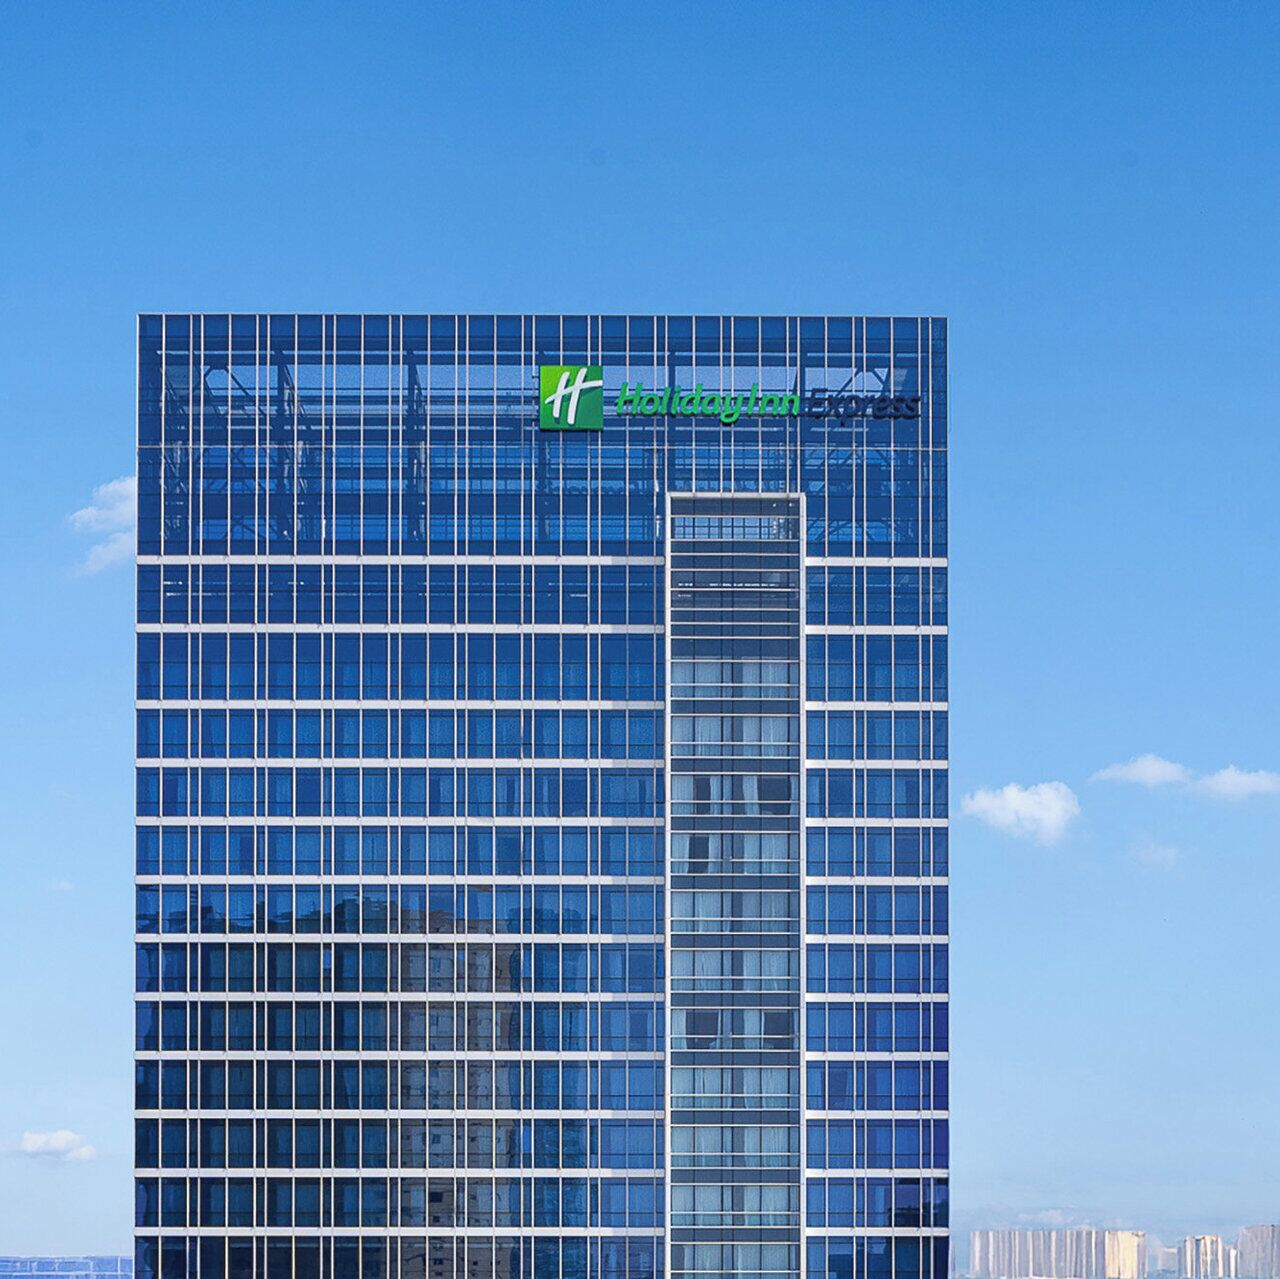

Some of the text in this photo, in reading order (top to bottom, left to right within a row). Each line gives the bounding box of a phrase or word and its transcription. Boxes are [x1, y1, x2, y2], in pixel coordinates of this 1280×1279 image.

[614, 382, 920, 427] Holiday Inn Express
